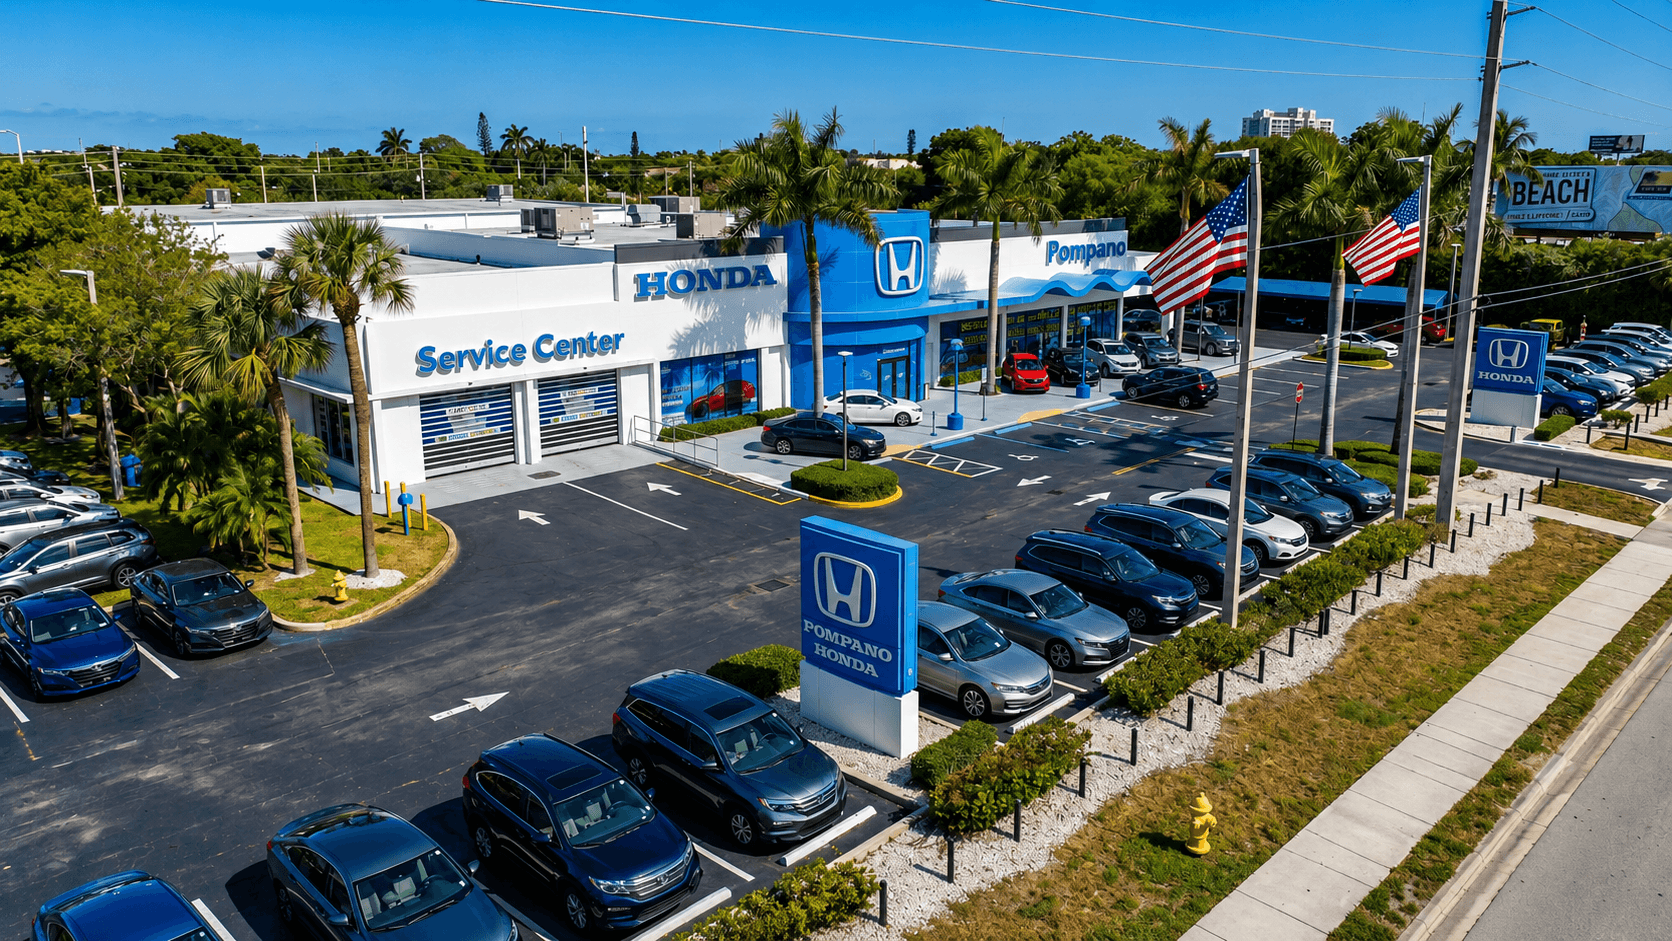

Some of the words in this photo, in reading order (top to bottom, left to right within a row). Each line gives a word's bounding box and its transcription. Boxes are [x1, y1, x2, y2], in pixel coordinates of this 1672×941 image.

[1512, 178, 1590, 206] BEACH
[1047, 240, 1126, 266] Pompano
[636, 264, 777, 298] HONDA
[416, 340, 527, 373] Service
[534, 331, 625, 360] Center
[1477, 371, 1535, 384] HONDA
[803, 619, 893, 663] POMPANO
[814, 642, 879, 678] HONDA
